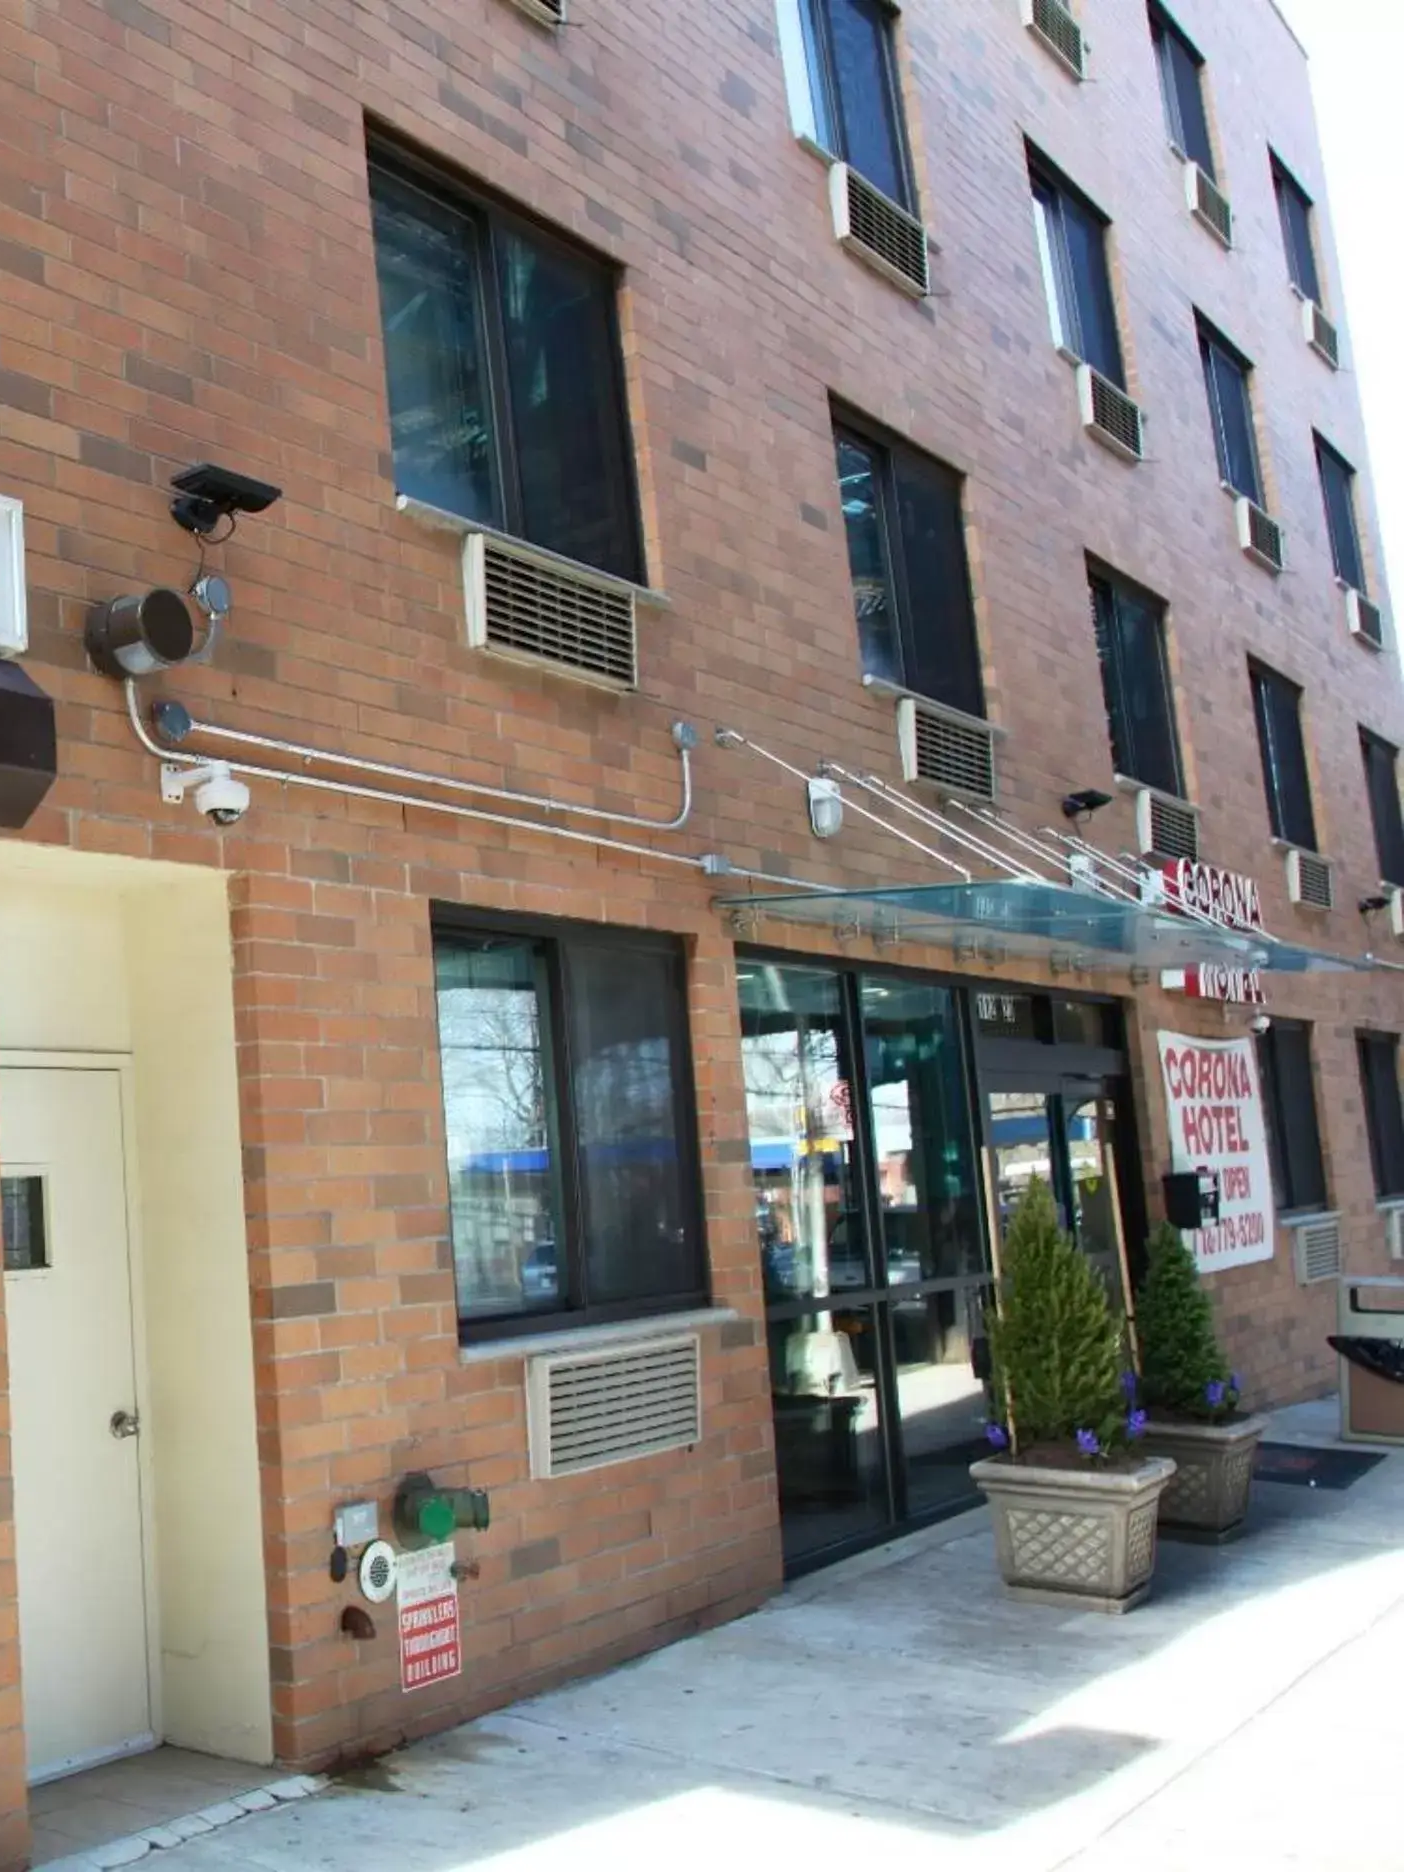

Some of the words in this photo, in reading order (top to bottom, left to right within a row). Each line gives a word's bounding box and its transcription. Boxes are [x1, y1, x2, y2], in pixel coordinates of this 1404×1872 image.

[1176, 856, 1264, 930] CORONA
[1165, 1047, 1252, 1100] CORONA
[1182, 1104, 1250, 1155] HOTEL
[1223, 1166, 1251, 1201] OPEN
[407, 1649, 457, 1682] BUILDING
